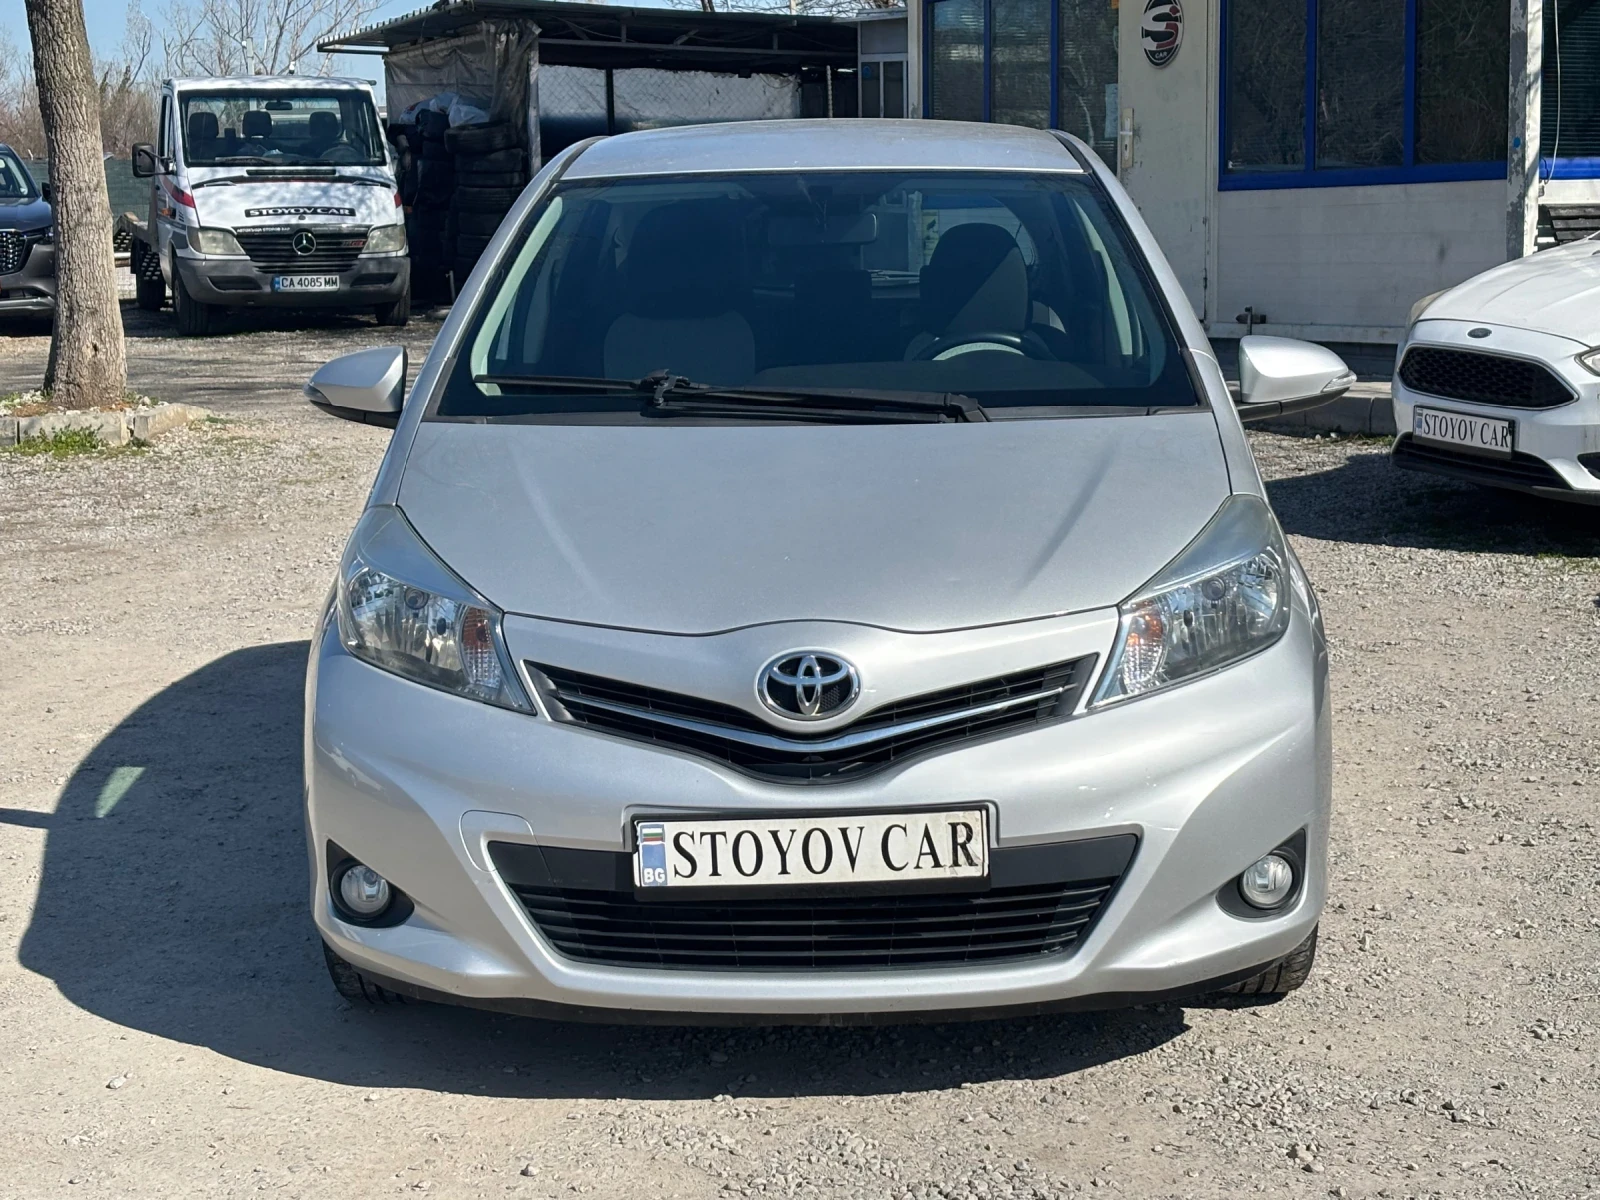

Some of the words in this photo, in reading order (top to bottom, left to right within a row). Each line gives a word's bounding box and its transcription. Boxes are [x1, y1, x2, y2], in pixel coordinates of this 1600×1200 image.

[249, 207, 314, 216] STOYOV
[281, 278, 295, 287] CA
[297, 277, 322, 287] 4085
[324, 277, 338, 287] MM
[1424, 413, 1477, 442] STOYOV
[1480, 422, 1509, 448] CAR
[672, 825, 865, 878] STOYOV
[880, 821, 979, 872] CAR
[643, 867, 666, 883] BG
